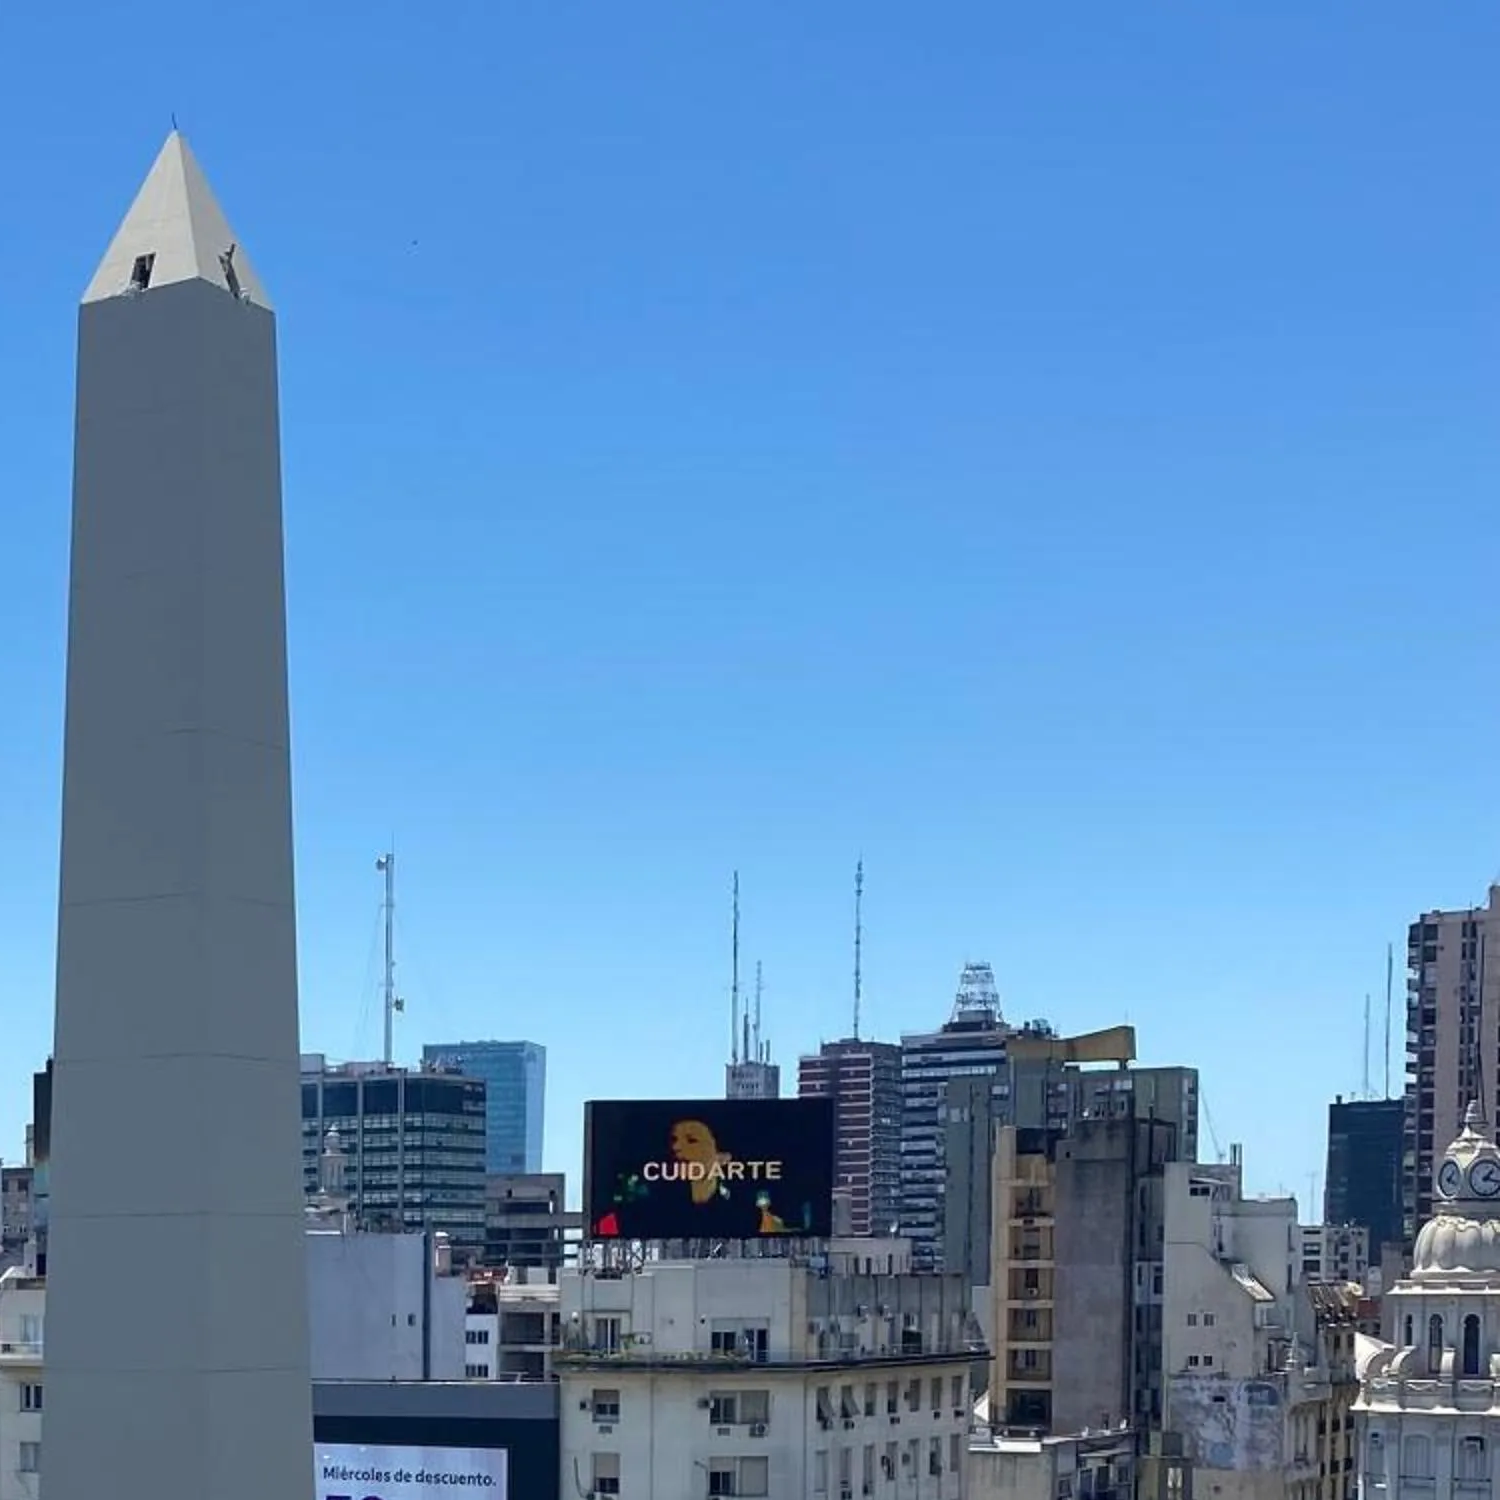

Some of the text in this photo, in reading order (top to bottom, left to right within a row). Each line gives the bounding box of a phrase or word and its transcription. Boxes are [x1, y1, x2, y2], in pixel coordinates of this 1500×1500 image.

[643, 1161, 783, 1181] CUIDARTE
[323, 1465, 496, 1487] Miércoles de descuento.
